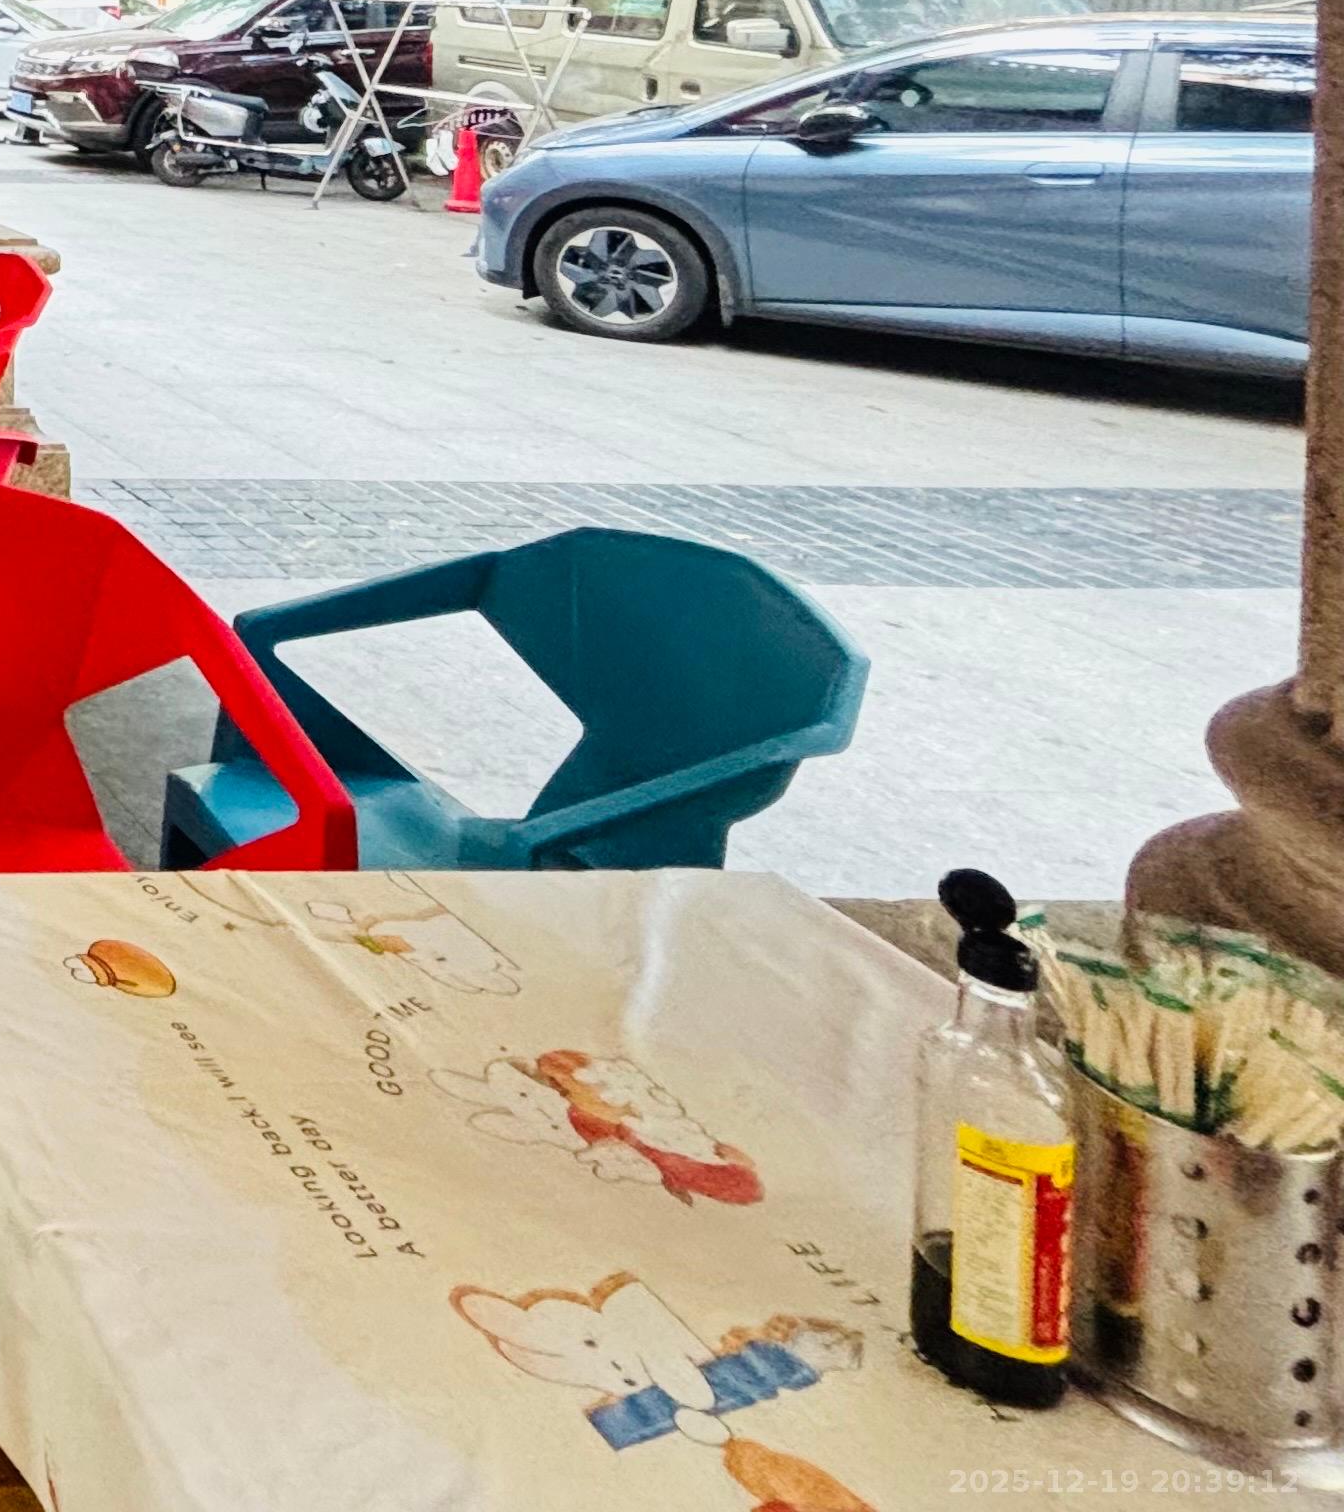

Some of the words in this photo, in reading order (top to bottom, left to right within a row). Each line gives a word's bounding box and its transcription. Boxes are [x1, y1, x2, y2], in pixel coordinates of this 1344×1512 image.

[171, 1021, 205, 1050] see
[194, 1057, 235, 1088] will
[365, 1029, 403, 1096] GOOD
[289, 1114, 332, 1152] day
[290, 1165, 377, 1259] Looking
[328, 1159, 400, 1231] better
[396, 1241, 426, 1258] A
